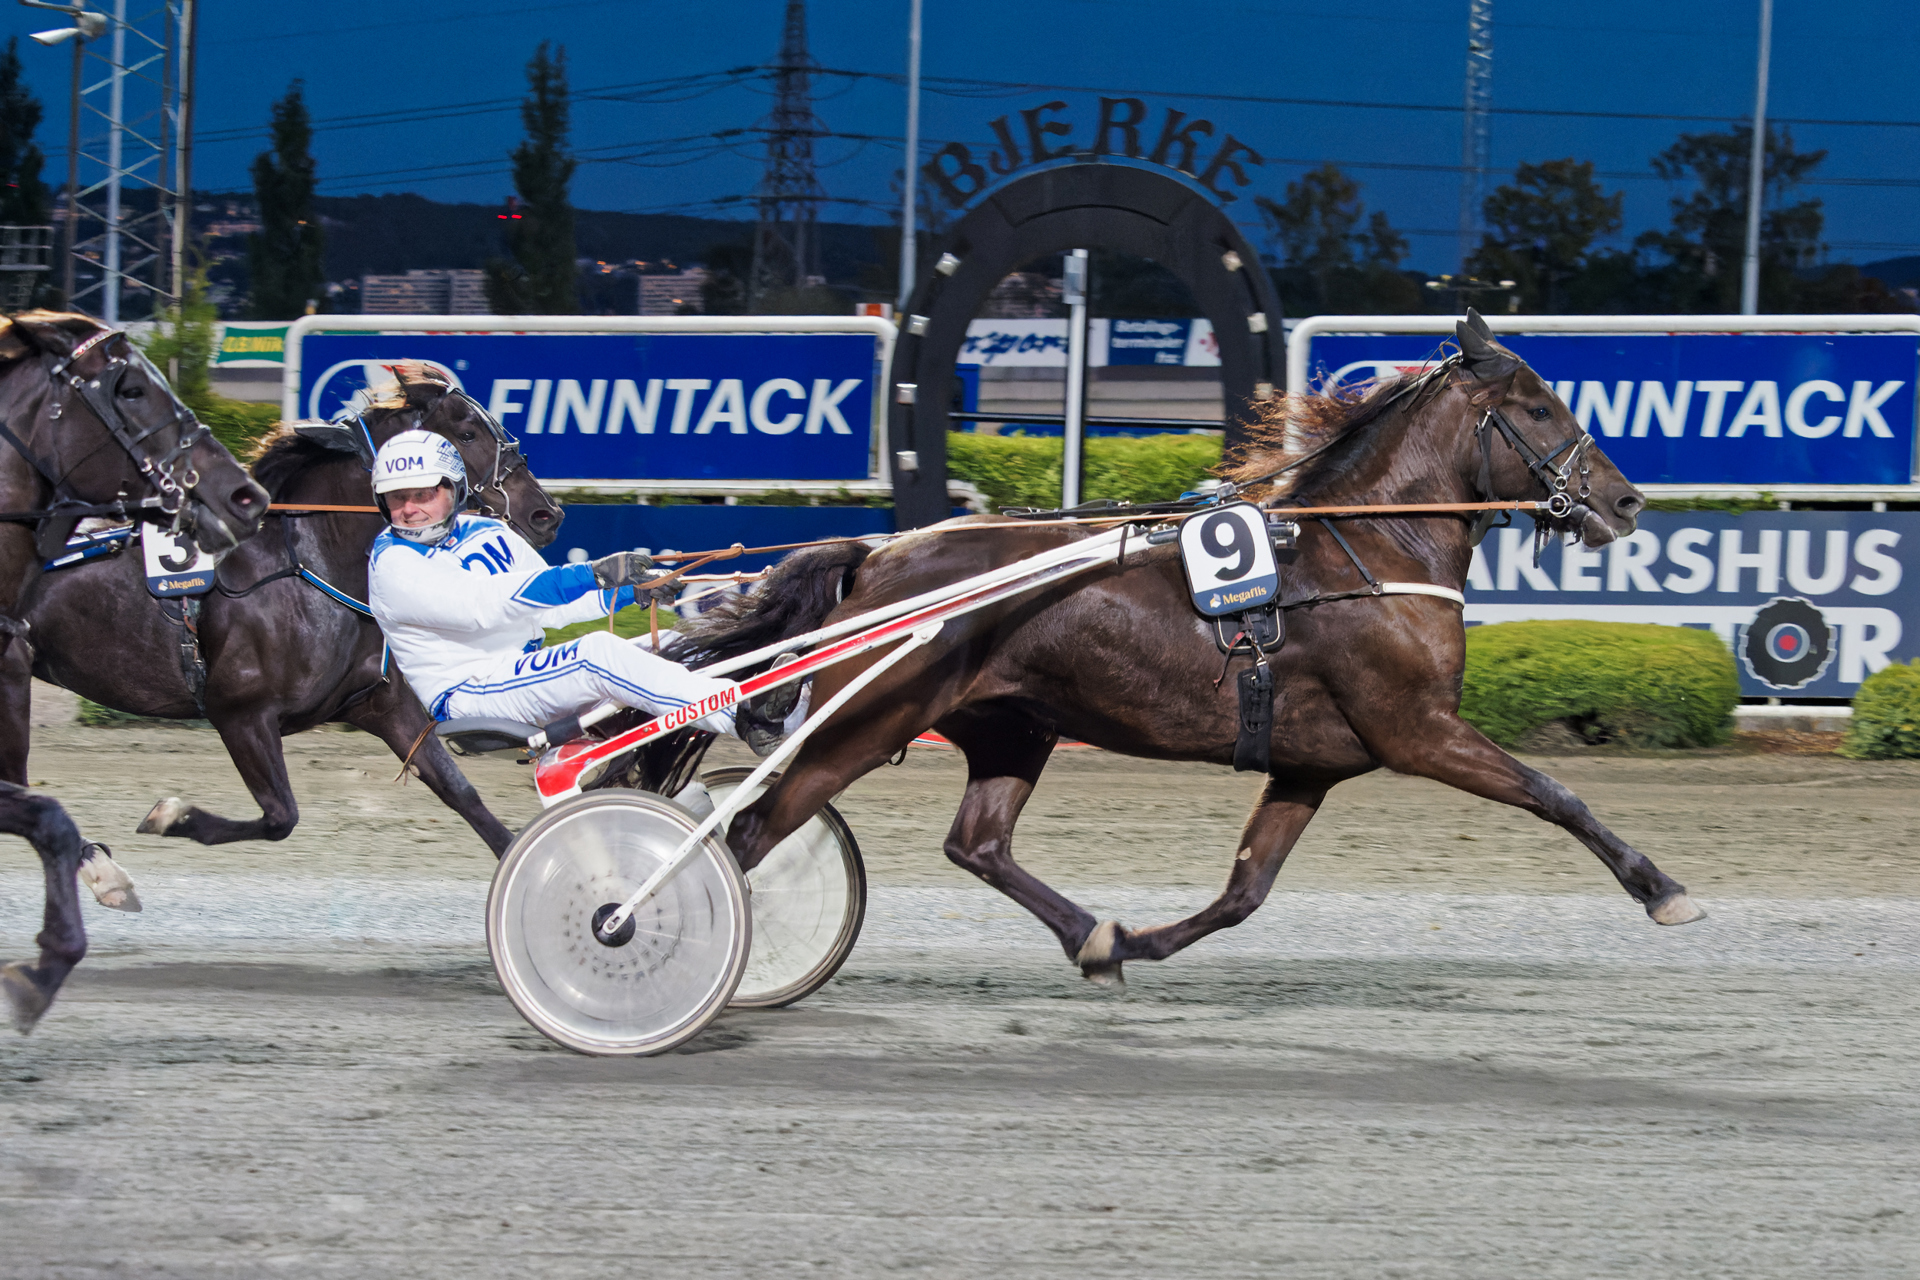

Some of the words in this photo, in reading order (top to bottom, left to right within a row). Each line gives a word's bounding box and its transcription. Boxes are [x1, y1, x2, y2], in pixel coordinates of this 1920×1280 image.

[922, 96, 1264, 211] BJERKE
[488, 378, 863, 435] FINNTACK
[1544, 379, 1906, 438] NNTACK
[385, 456, 425, 474] VOM
[157, 524, 200, 573] 3
[459, 534, 516, 577] OM
[1200, 511, 1256, 581] 9
[168, 577, 206, 591] Megaflis
[1221, 585, 1268, 606] Megaflis
[514, 637, 583, 676] VOM
[664, 686, 737, 730] CUSTOM
